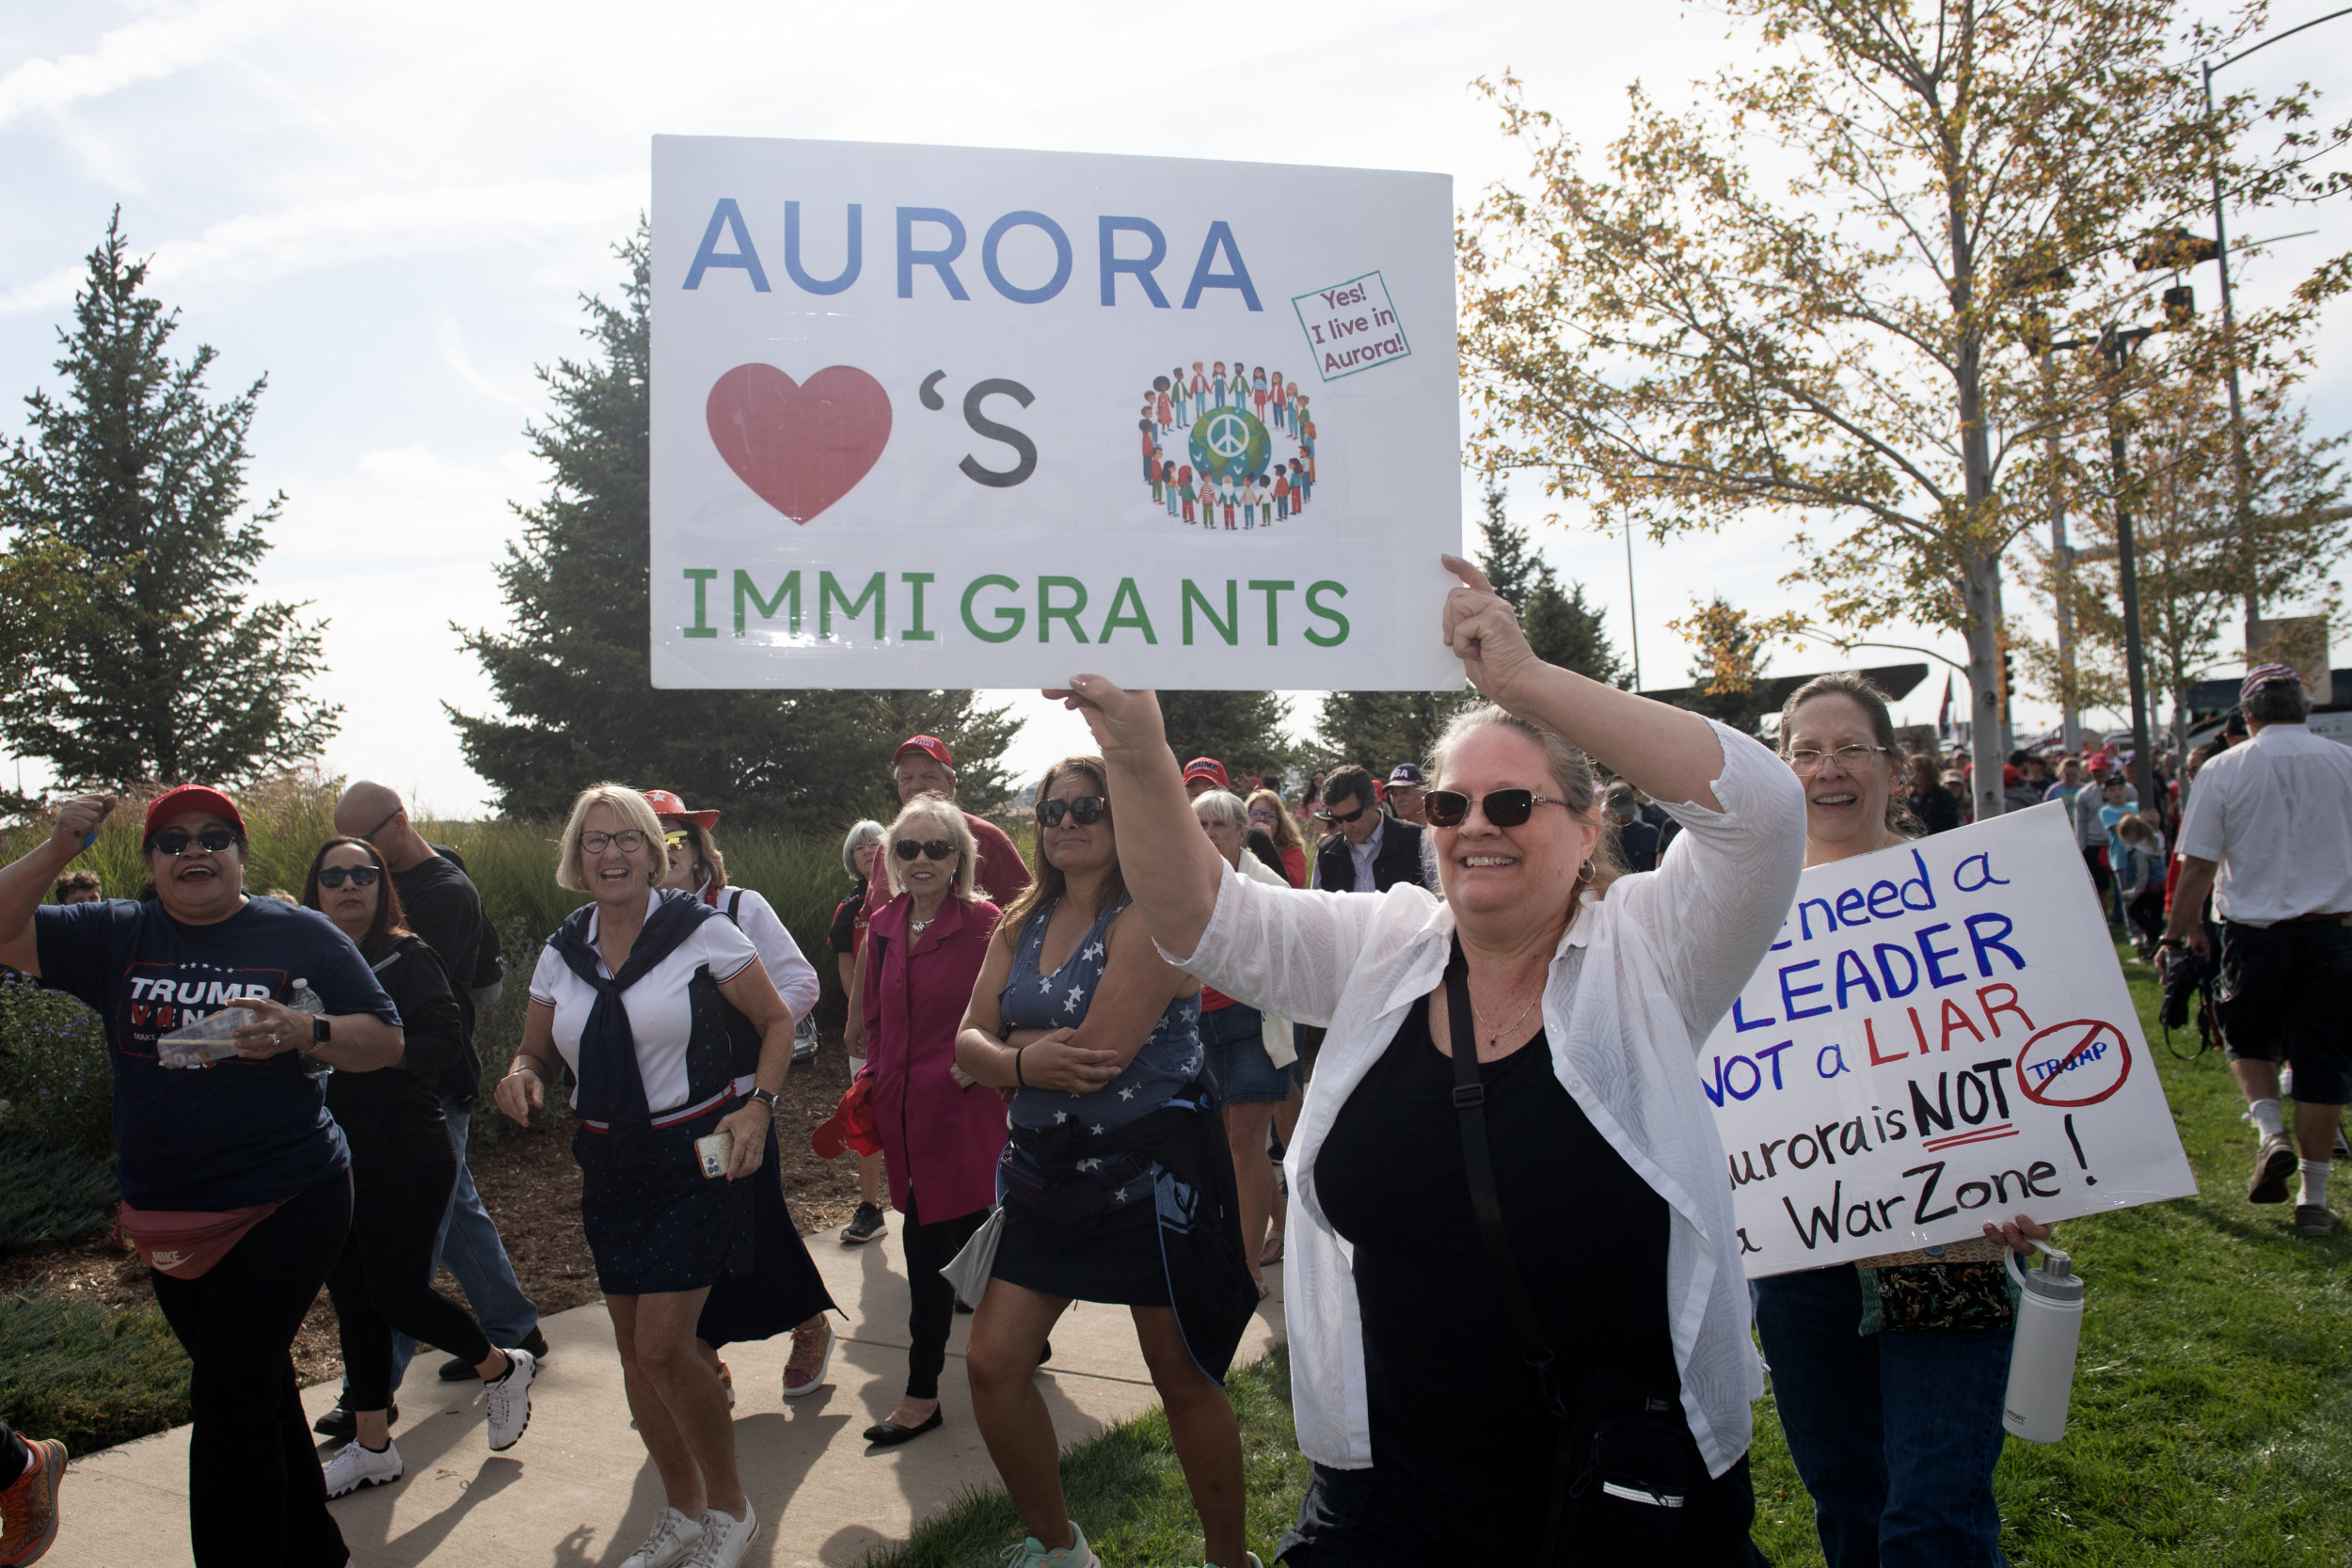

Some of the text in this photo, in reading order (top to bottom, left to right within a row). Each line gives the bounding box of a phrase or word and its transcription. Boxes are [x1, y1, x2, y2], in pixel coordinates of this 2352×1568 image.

[682, 198, 1263, 312] AURORA
[1319, 282, 1367, 309] Yes!
[1311, 307, 1395, 344] I live in
[1325, 333, 1405, 372] Aurora!
[682, 567, 1351, 648] IMMIGRANTS
[1798, 848, 1936, 942] need
[1953, 851, 2011, 893] a
[130, 976, 270, 1005] TRUMP
[1732, 912, 2026, 1034] LEADER
[134, 1033, 157, 1041] MAKE
[1700, 982, 2036, 1108] NOT a LIAR
[2026, 1041, 2108, 1081] TRUMP
[1729, 1057, 2012, 1192] urora is NOT
[1782, 1180, 1906, 1250] War
[151, 1250, 180, 1262] NIKE
[39, 1474, 51, 1511] HOKA
